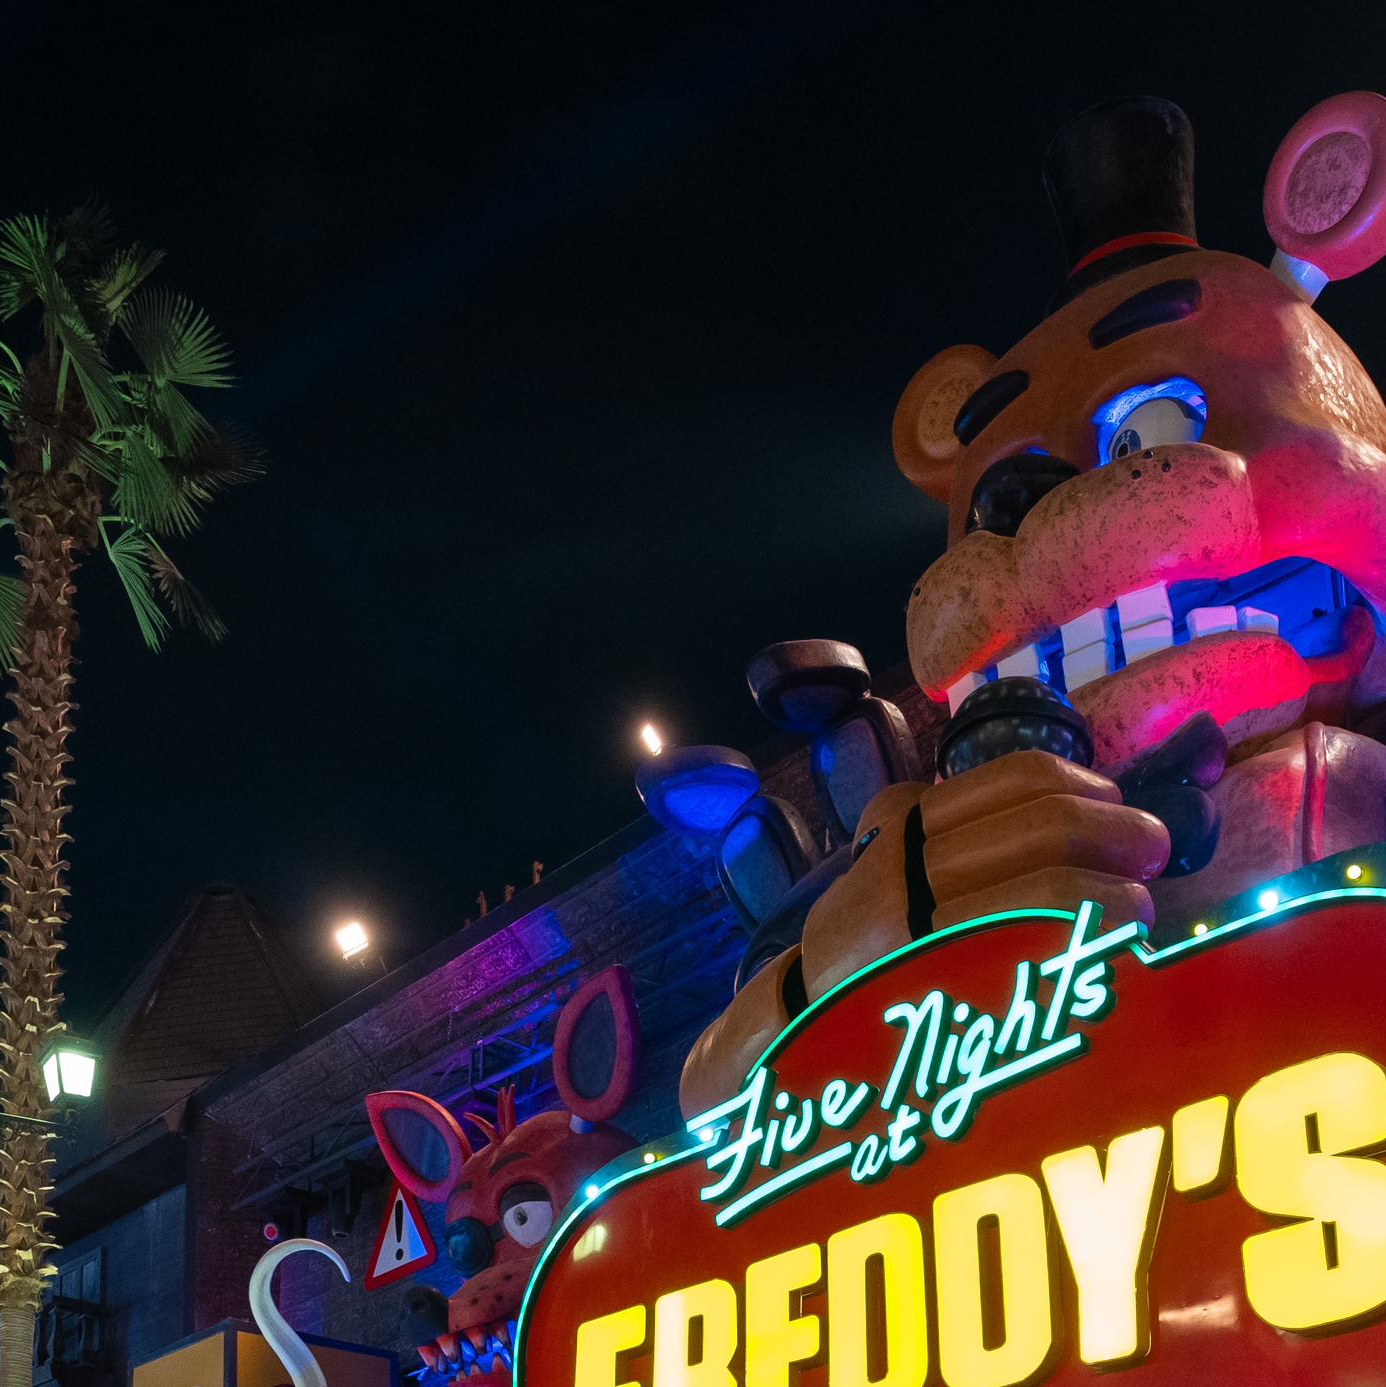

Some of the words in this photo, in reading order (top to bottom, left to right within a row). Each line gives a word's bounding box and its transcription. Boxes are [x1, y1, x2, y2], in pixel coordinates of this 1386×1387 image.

[686, 1066, 869, 1202] Five
[881, 899, 1149, 1140] Nights
[850, 1104, 919, 1183] at
